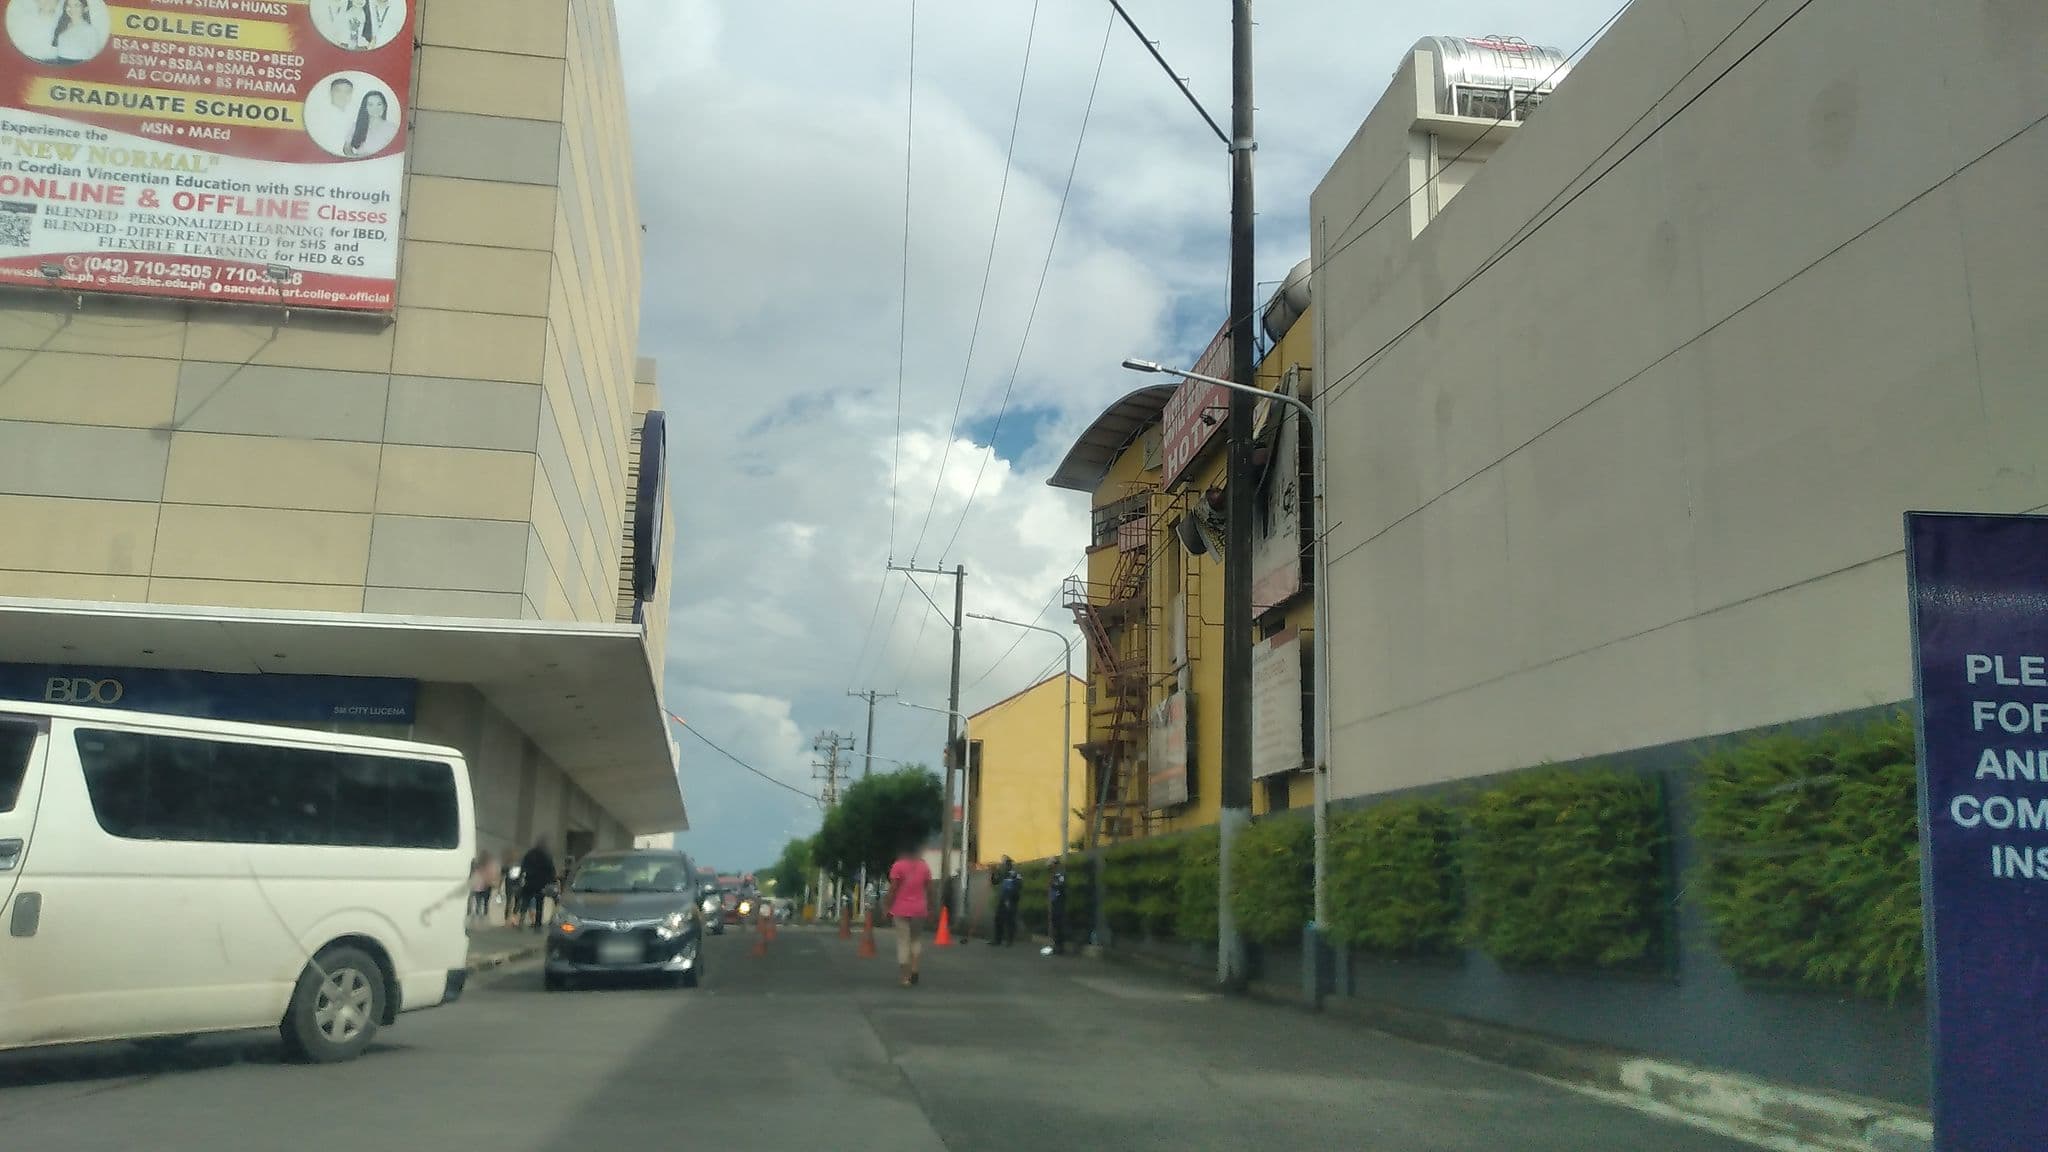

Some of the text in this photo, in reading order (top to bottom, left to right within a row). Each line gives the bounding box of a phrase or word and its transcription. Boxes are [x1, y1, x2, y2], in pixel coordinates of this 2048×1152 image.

[240, 3, 288, 16] HUMSS
[126, 14, 239, 39] COLLEGE
[113, 38, 140, 51] BSA
[188, 45, 214, 58] BSN
[227, 49, 260, 63] BSED
[271, 53, 304, 67] BEED
[119, 53, 302, 81] BSSW BSBA BSMA BSCS
[126, 68, 297, 94] AB COMM BS PHARMA
[50, 85, 294, 123] GRADUATE SCHOOL
[1, 120, 108, 142] Experience the
[141, 121, 231, 140] MSN MAEd
[18, 160, 81, 178] Cordian
[88, 167, 169, 186] Vincentian
[175, 174, 250, 192] Education
[256, 182, 289, 195] with
[294, 185, 325, 198] SHC
[330, 187, 390, 204] through
[0, 175, 388, 223] ONLINE & OFFLINE Classes
[43, 219, 116, 234] BLENDED
[276, 238, 294, 248] for
[300, 240, 326, 250] SHS
[334, 242, 359, 252] and
[129, 212, 244, 231] PERSONALIZED
[246, 221, 323, 238] LEARNING
[330, 227, 349, 238] for
[184, 242, 267, 260] LEARNING
[274, 251, 294, 261] for
[299, 253, 326, 264] HED
[331, 255, 343, 265] &
[346, 256, 364, 266] GS
[84, 256, 129, 275] (042)
[134, 260, 211, 279] 710-2505
[45, 677, 123, 704] BDO
[348, 706, 368, 714] CITY
[370, 707, 405, 715] LUCENA
